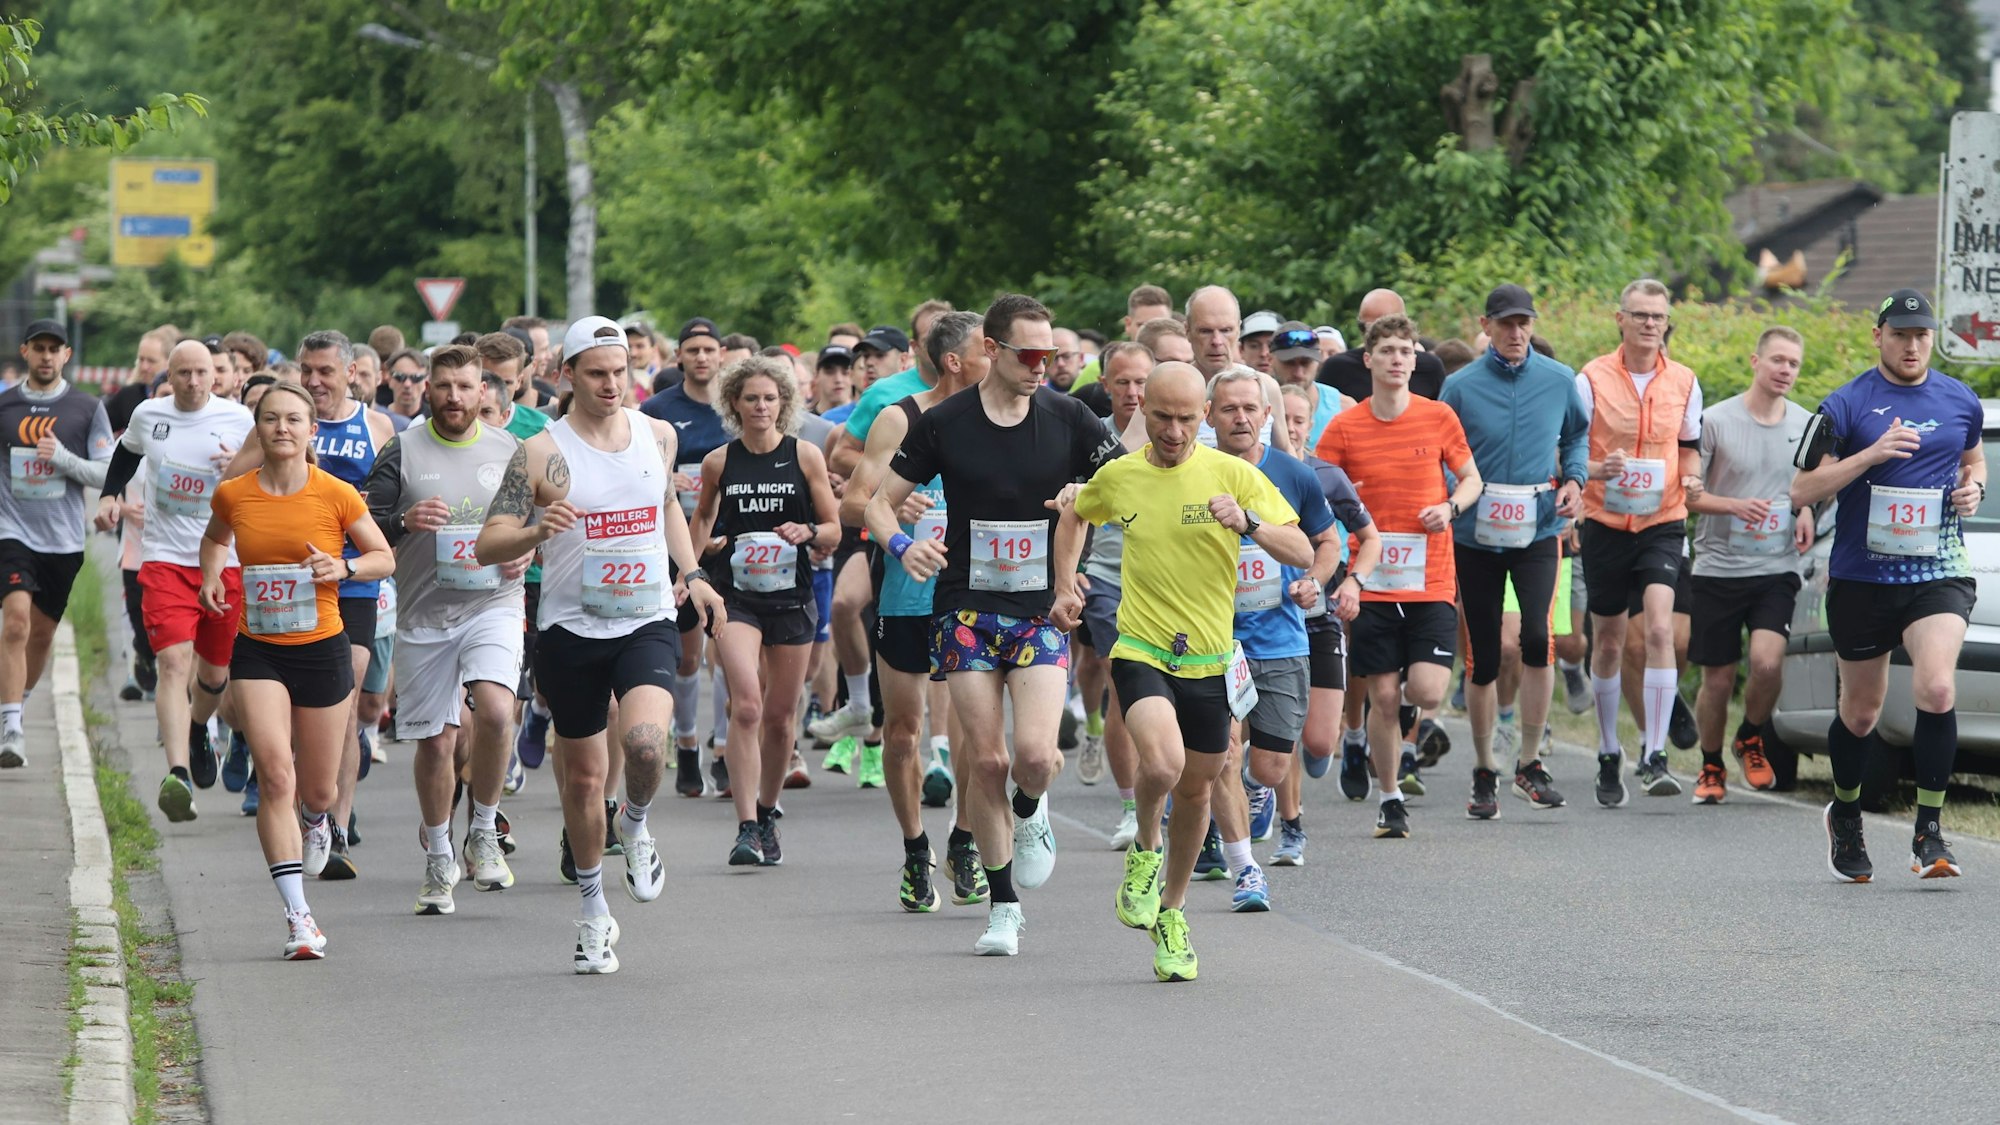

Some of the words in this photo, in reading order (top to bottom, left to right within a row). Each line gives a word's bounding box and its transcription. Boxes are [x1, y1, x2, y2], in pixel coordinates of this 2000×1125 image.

[1954, 222, 2000, 253] IM
[23, 460, 54, 476] 199
[170, 474, 204, 494] 309
[1618, 471, 1652, 488] 229
[726, 484, 754, 496] HEUL
[757, 483, 795, 495] NICHT,
[738, 498, 784, 513] LAUF!
[1489, 502, 1524, 520] 208
[1888, 503, 1926, 524] 131
[606, 510, 649, 523] MILERS
[606, 521, 654, 536] COLONIA
[744, 545, 782, 564] 227
[989, 538, 1032, 559] 119
[1380, 546, 1412, 564] 197
[601, 562, 646, 584] 222
[256, 580, 297, 602] 257
